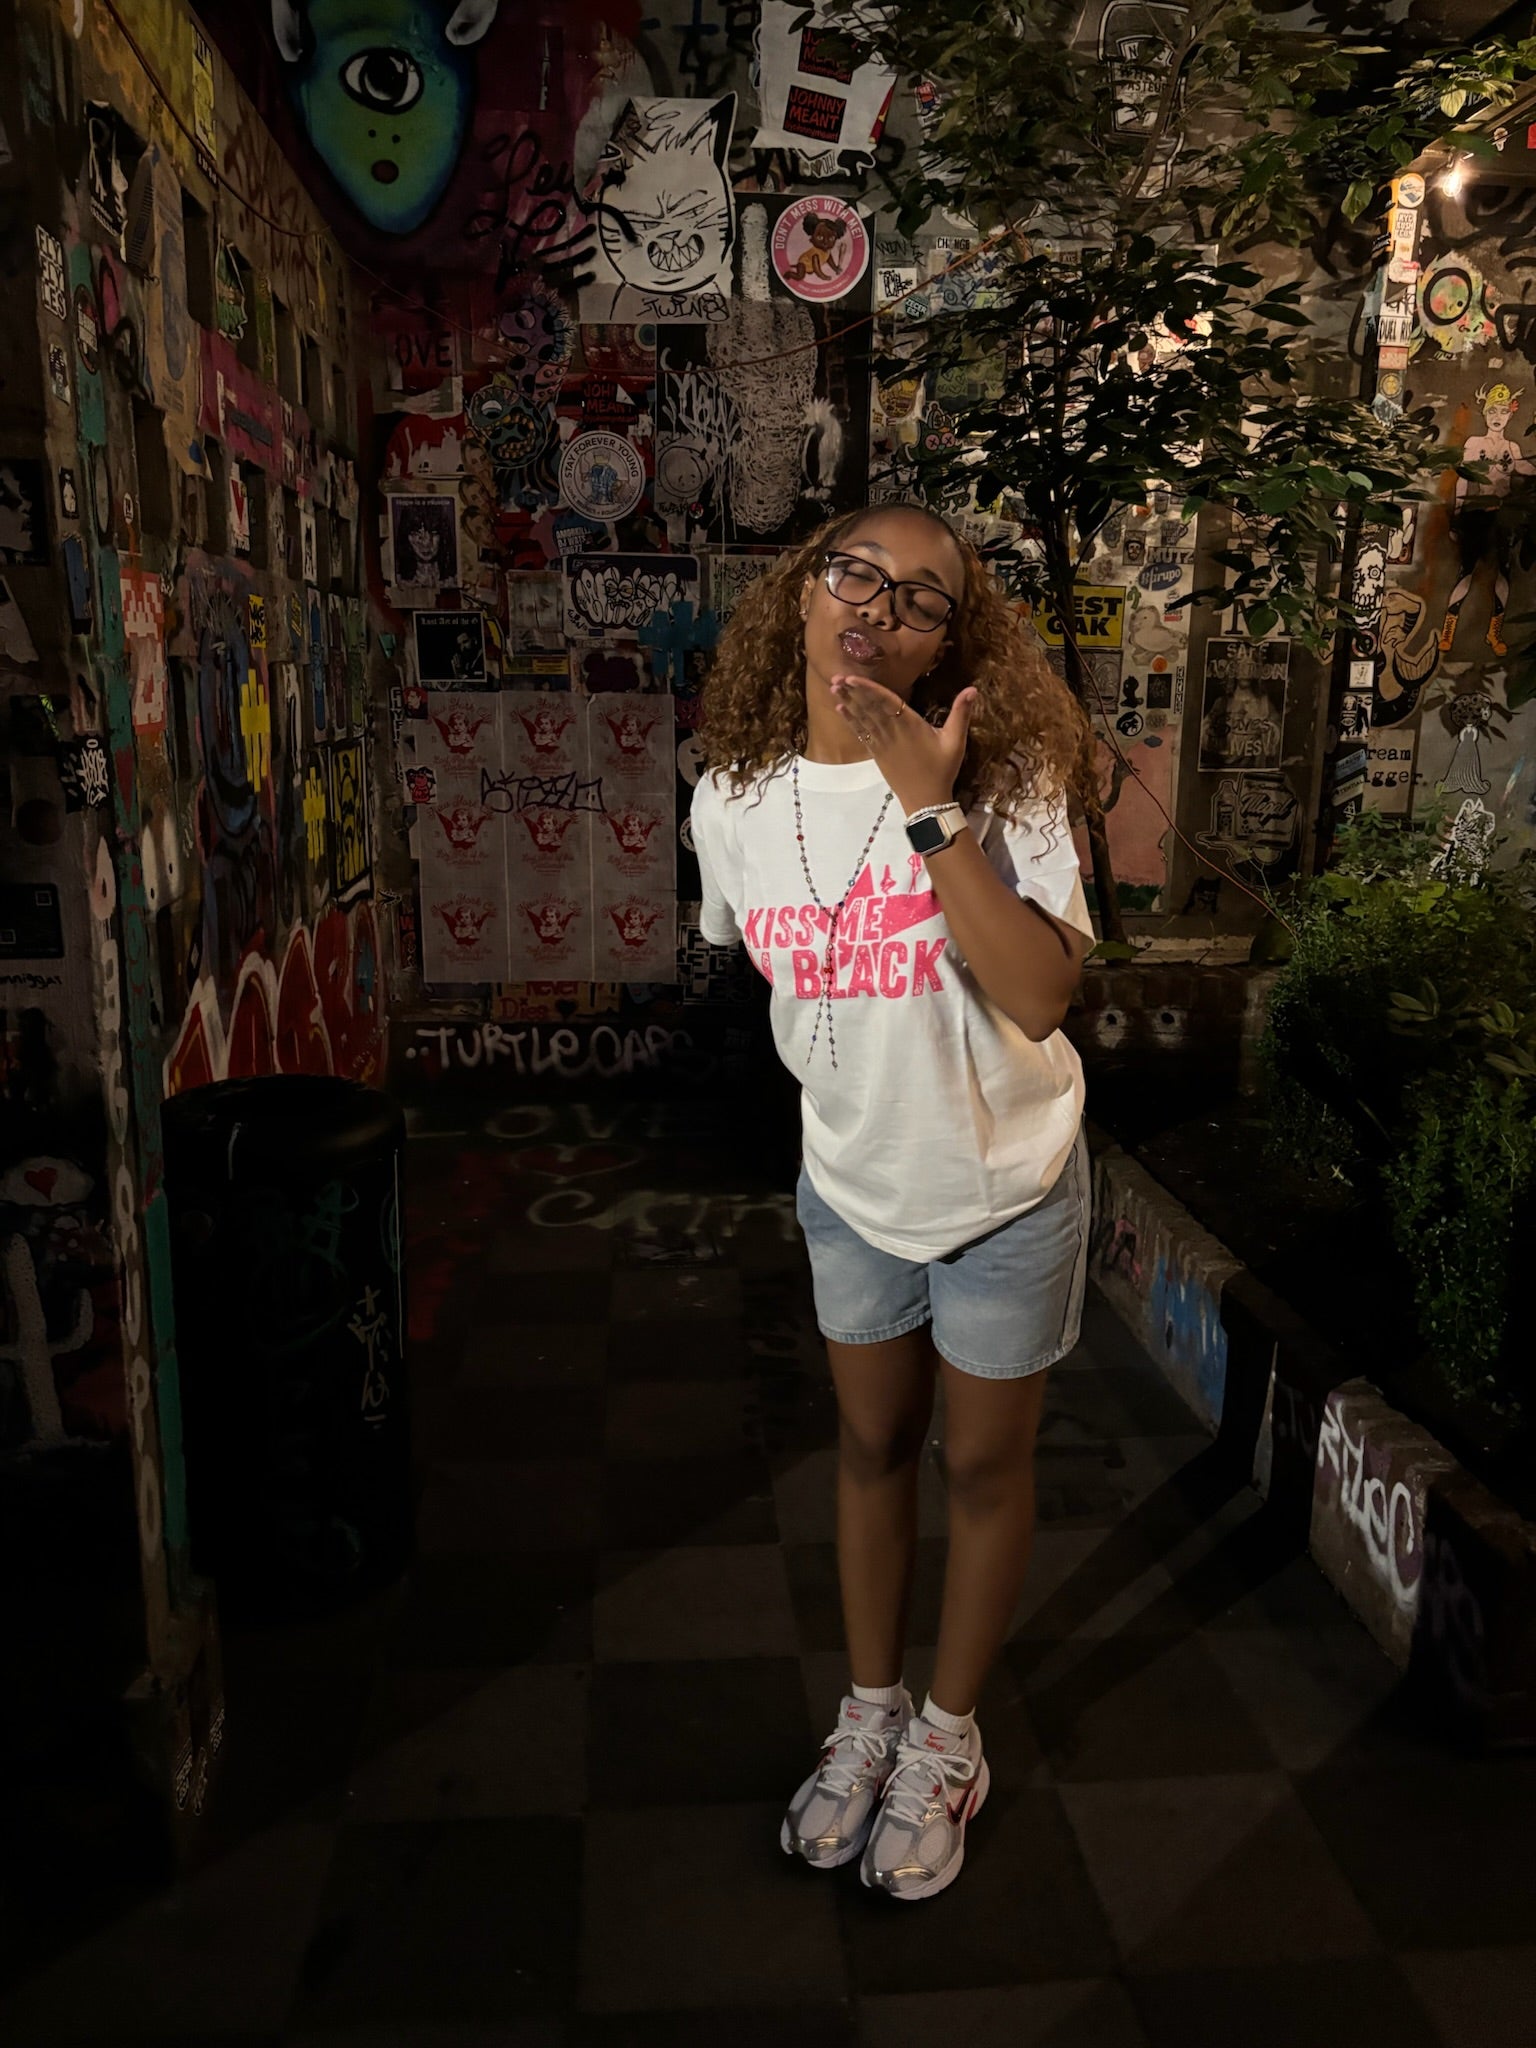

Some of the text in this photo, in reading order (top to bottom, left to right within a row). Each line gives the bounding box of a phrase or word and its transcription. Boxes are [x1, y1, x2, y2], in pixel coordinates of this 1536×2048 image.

[789, 104, 840, 131] MEANT
[790, 88, 846, 115] JOHNNY
[775, 218, 791, 249] DON'T
[790, 200, 818, 220] MESS
[824, 199, 849, 219] WITH
[565, 437, 639, 478] STAY FOREVER YOUNG
[1367, 749, 1411, 760] ream
[1364, 768, 1428, 787] igger.
[745, 904, 817, 949] KISS
[833, 897, 884, 943] ME
[792, 938, 947, 1000] BLACK
